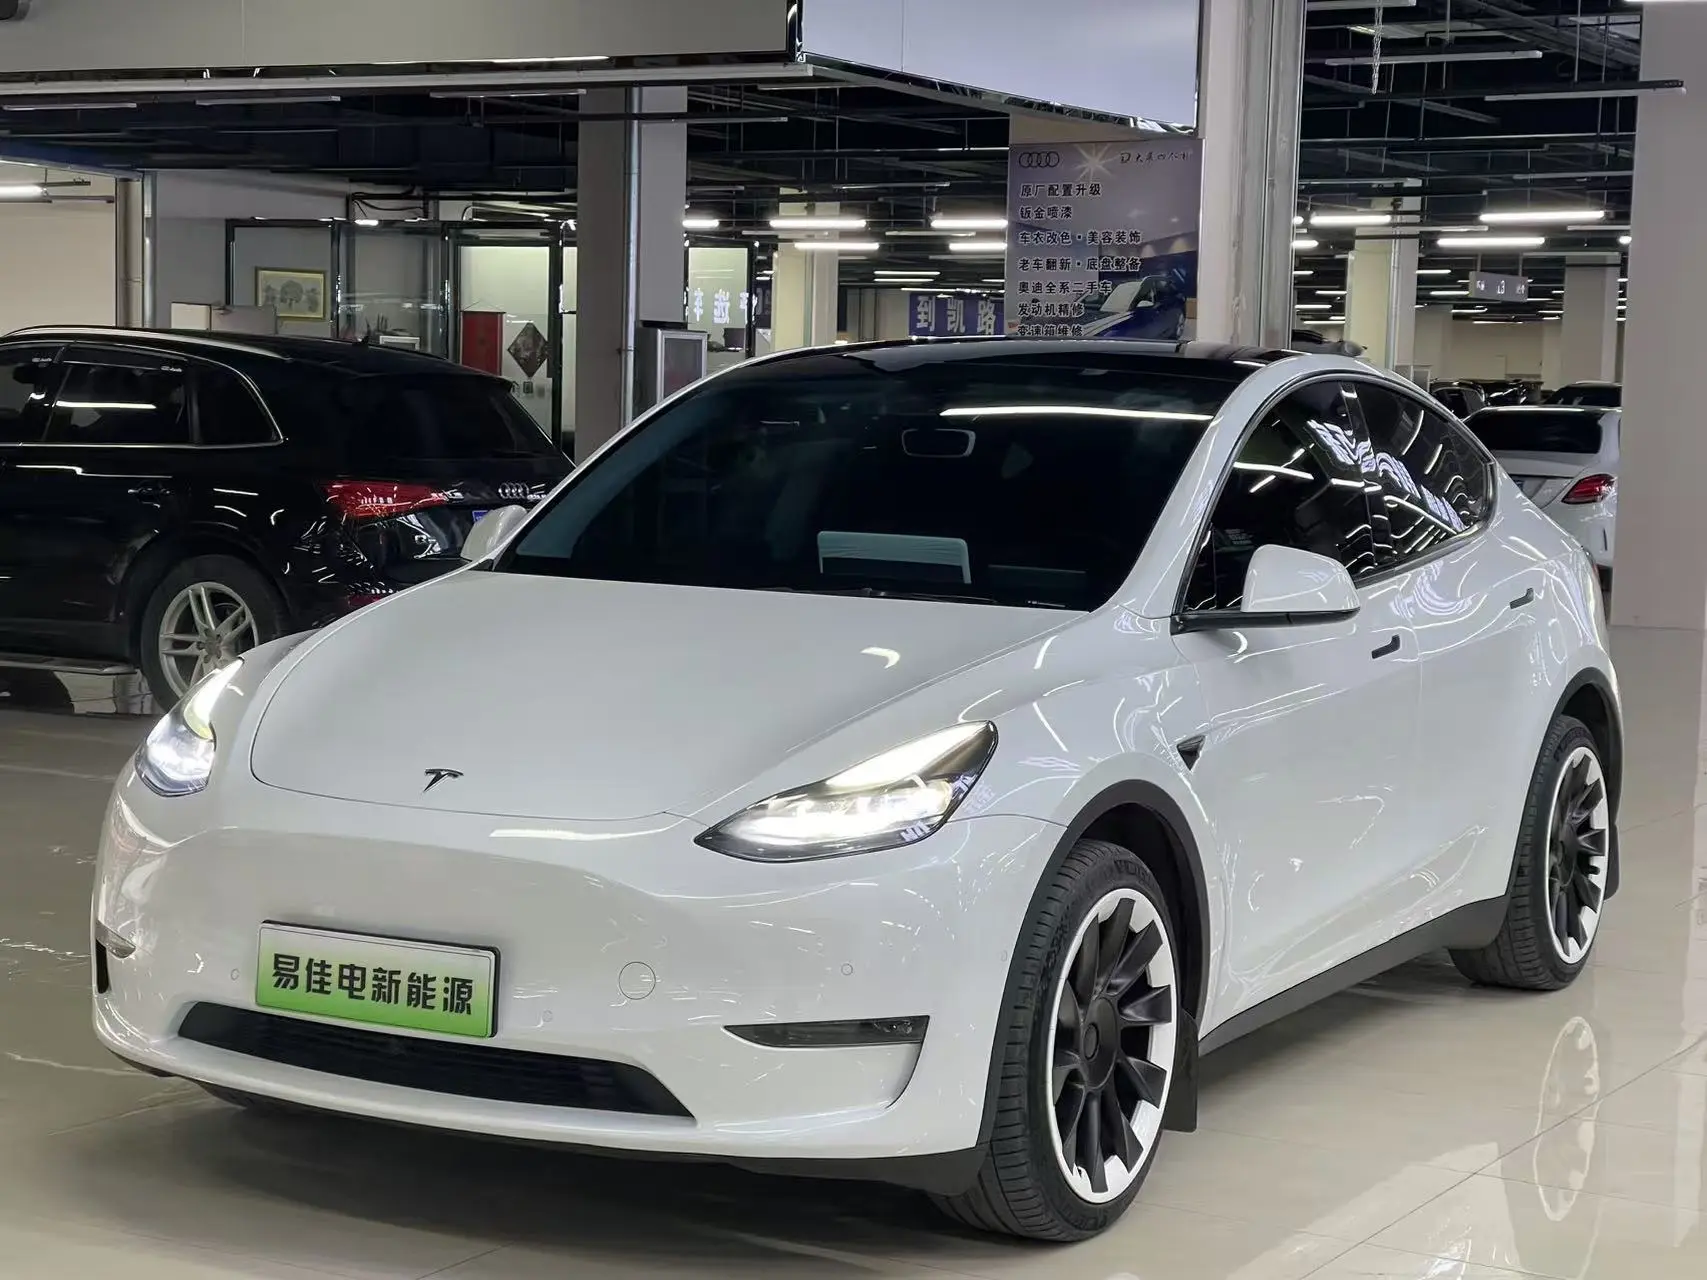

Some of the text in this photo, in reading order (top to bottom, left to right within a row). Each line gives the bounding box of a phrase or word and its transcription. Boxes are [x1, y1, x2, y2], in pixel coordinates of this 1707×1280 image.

[1020, 183, 1101, 197] 原厂配置升级
[1020, 206, 1073, 220] 钣金喷漆
[1018, 281, 1113, 294] 奥迪全系二手车
[1017, 303, 1085, 317] 发动机精修
[272, 953, 473, 1015] 易佳电新能源
